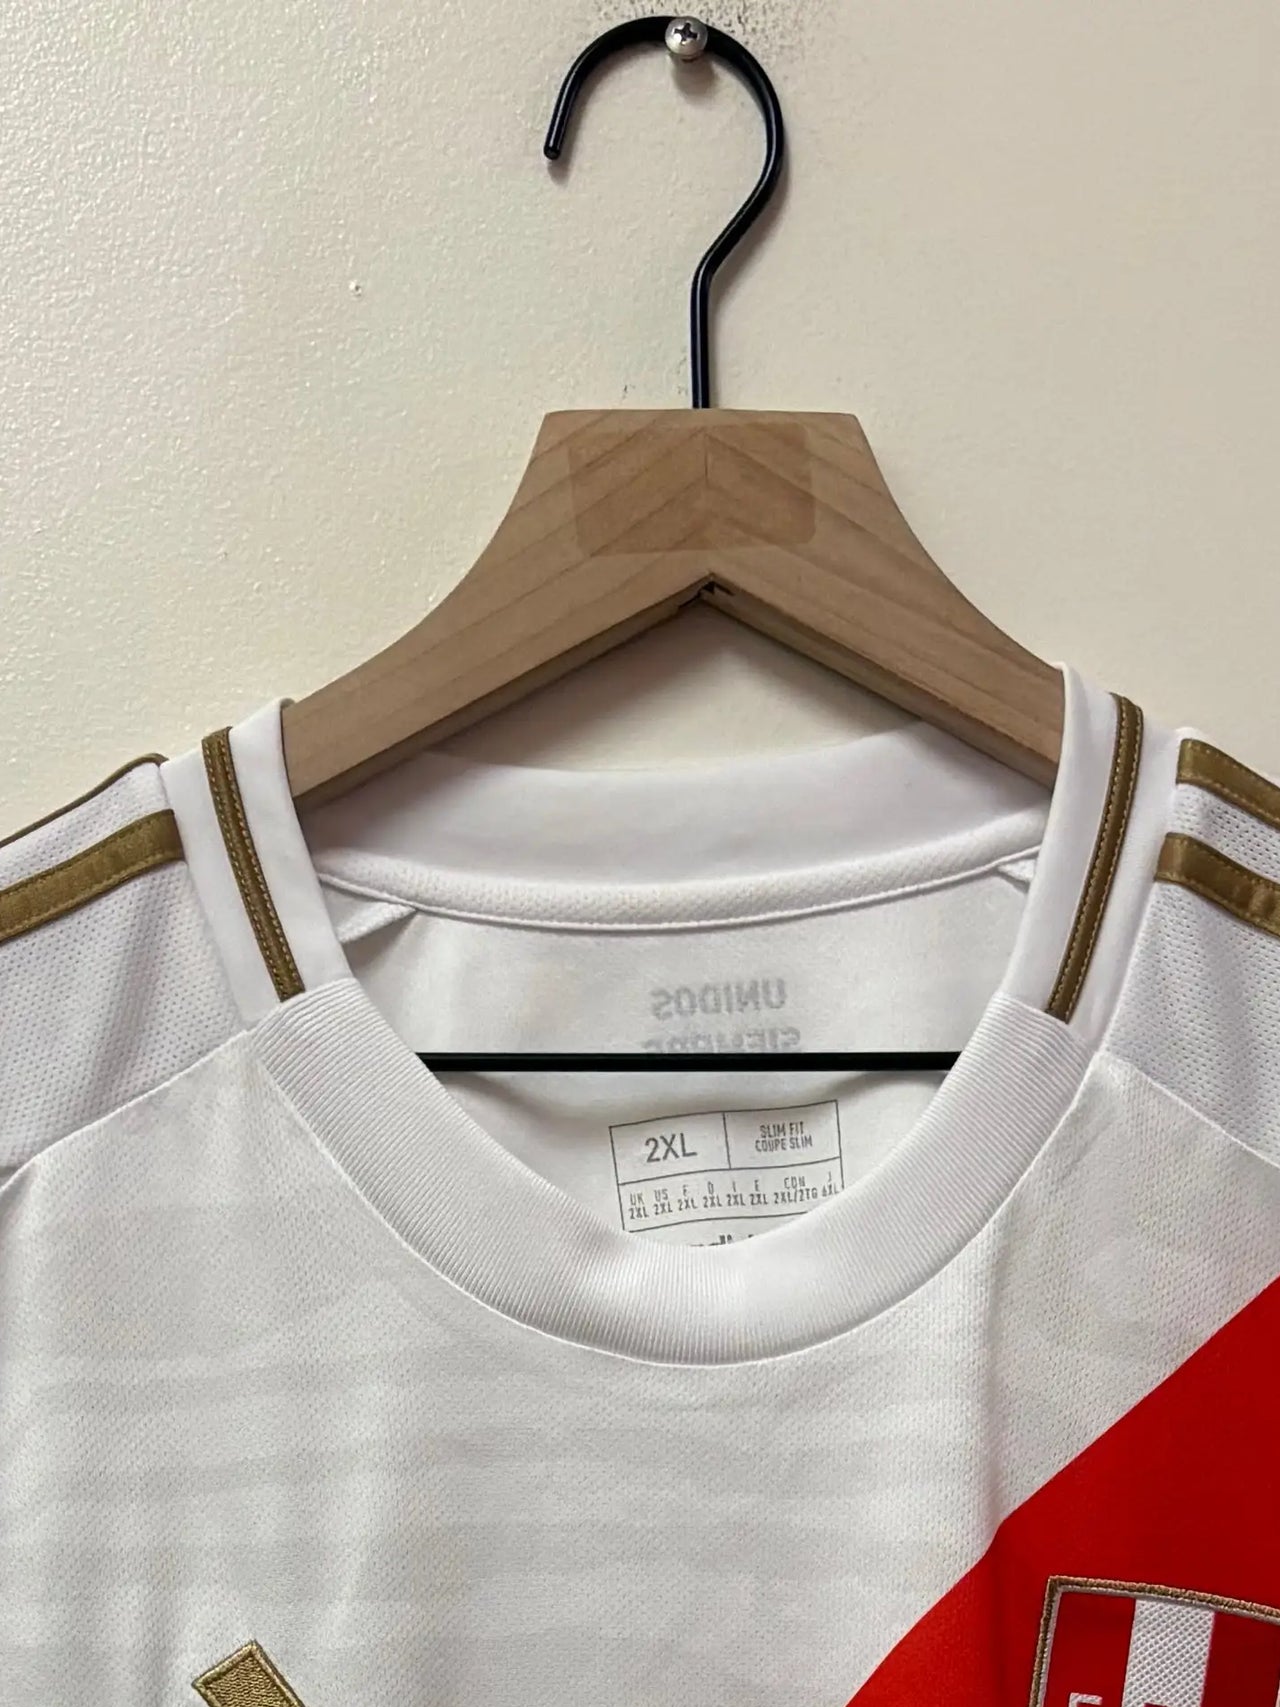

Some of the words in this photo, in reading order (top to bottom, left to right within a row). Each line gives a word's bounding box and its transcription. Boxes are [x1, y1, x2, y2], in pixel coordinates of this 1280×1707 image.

[760, 1122, 786, 1139] SLIM
[789, 1120, 804, 1136] FIT
[643, 1132, 698, 1164] 2XL
[755, 1138, 787, 1153] COUPE
[789, 1134, 813, 1150] SLIM
[629, 1192, 645, 1206] UK
[653, 1188, 669, 1202] US
[629, 1206, 649, 1220] 2XL
[653, 1201, 673, 1216] 2XL
[677, 1198, 698, 1211] 2XL
[703, 1195, 723, 1208] 2XL
[726, 1193, 746, 1207] 2XL
[749, 1193, 769, 1206] 2XL
